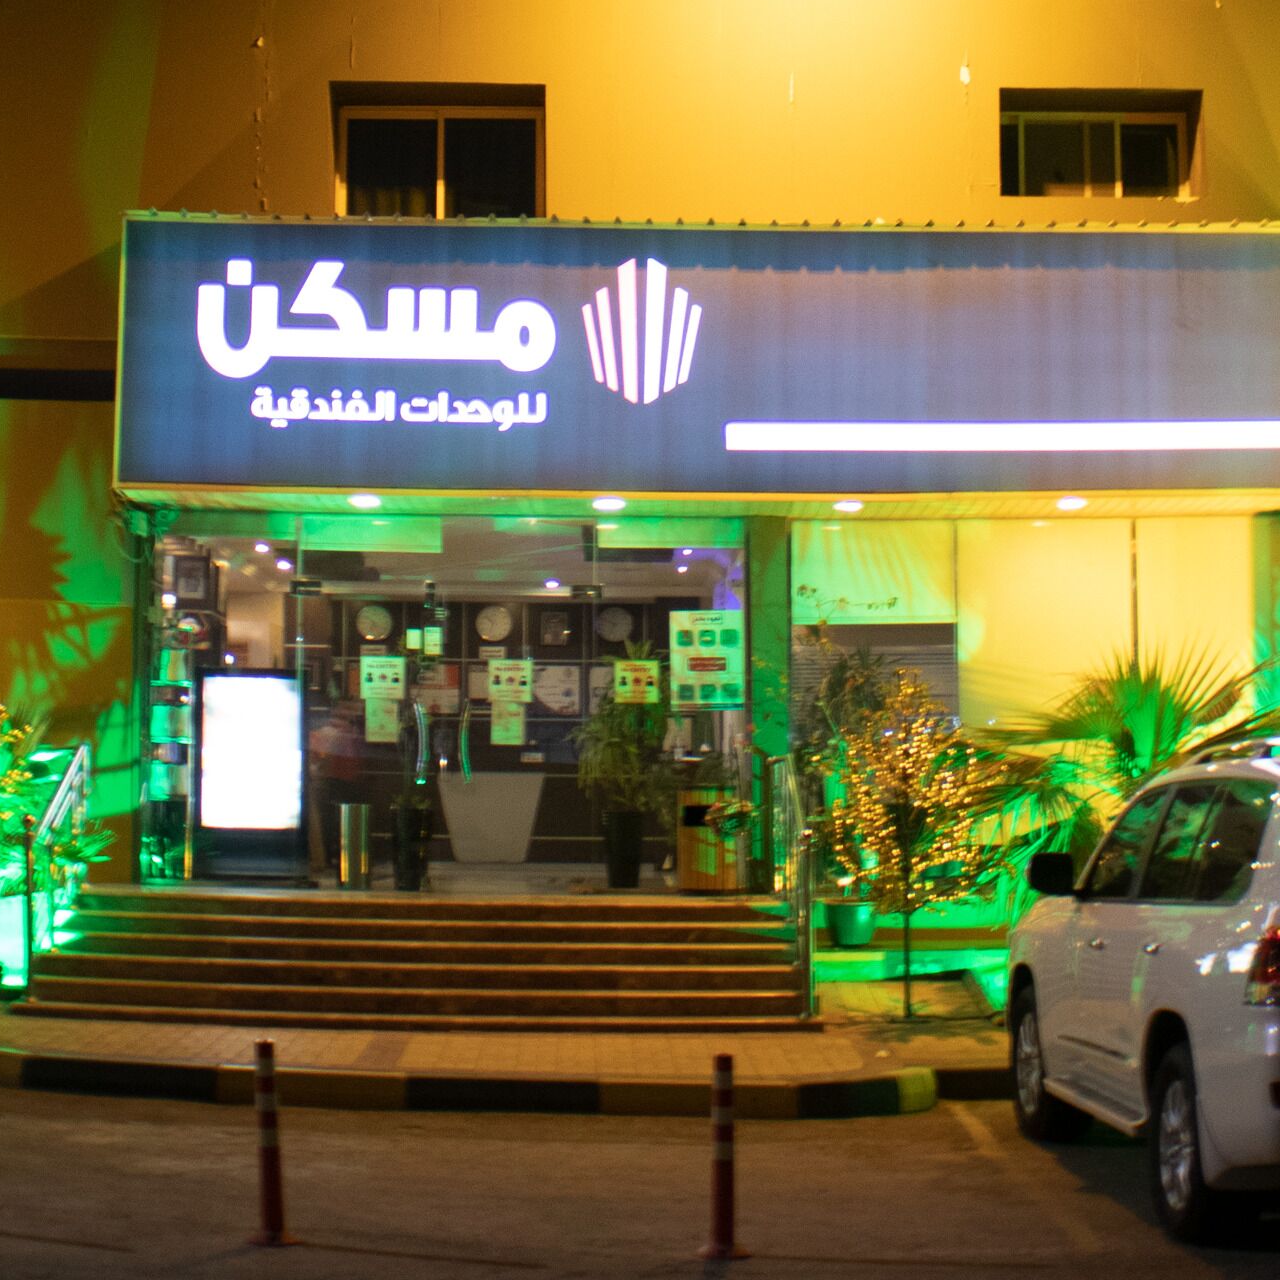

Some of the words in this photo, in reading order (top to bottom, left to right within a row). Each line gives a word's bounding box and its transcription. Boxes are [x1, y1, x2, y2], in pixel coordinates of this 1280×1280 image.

[196, 258, 557, 379] مسكن
[250, 386, 397, 429] الفندقية
[399, 390, 548, 432] للوحدات
